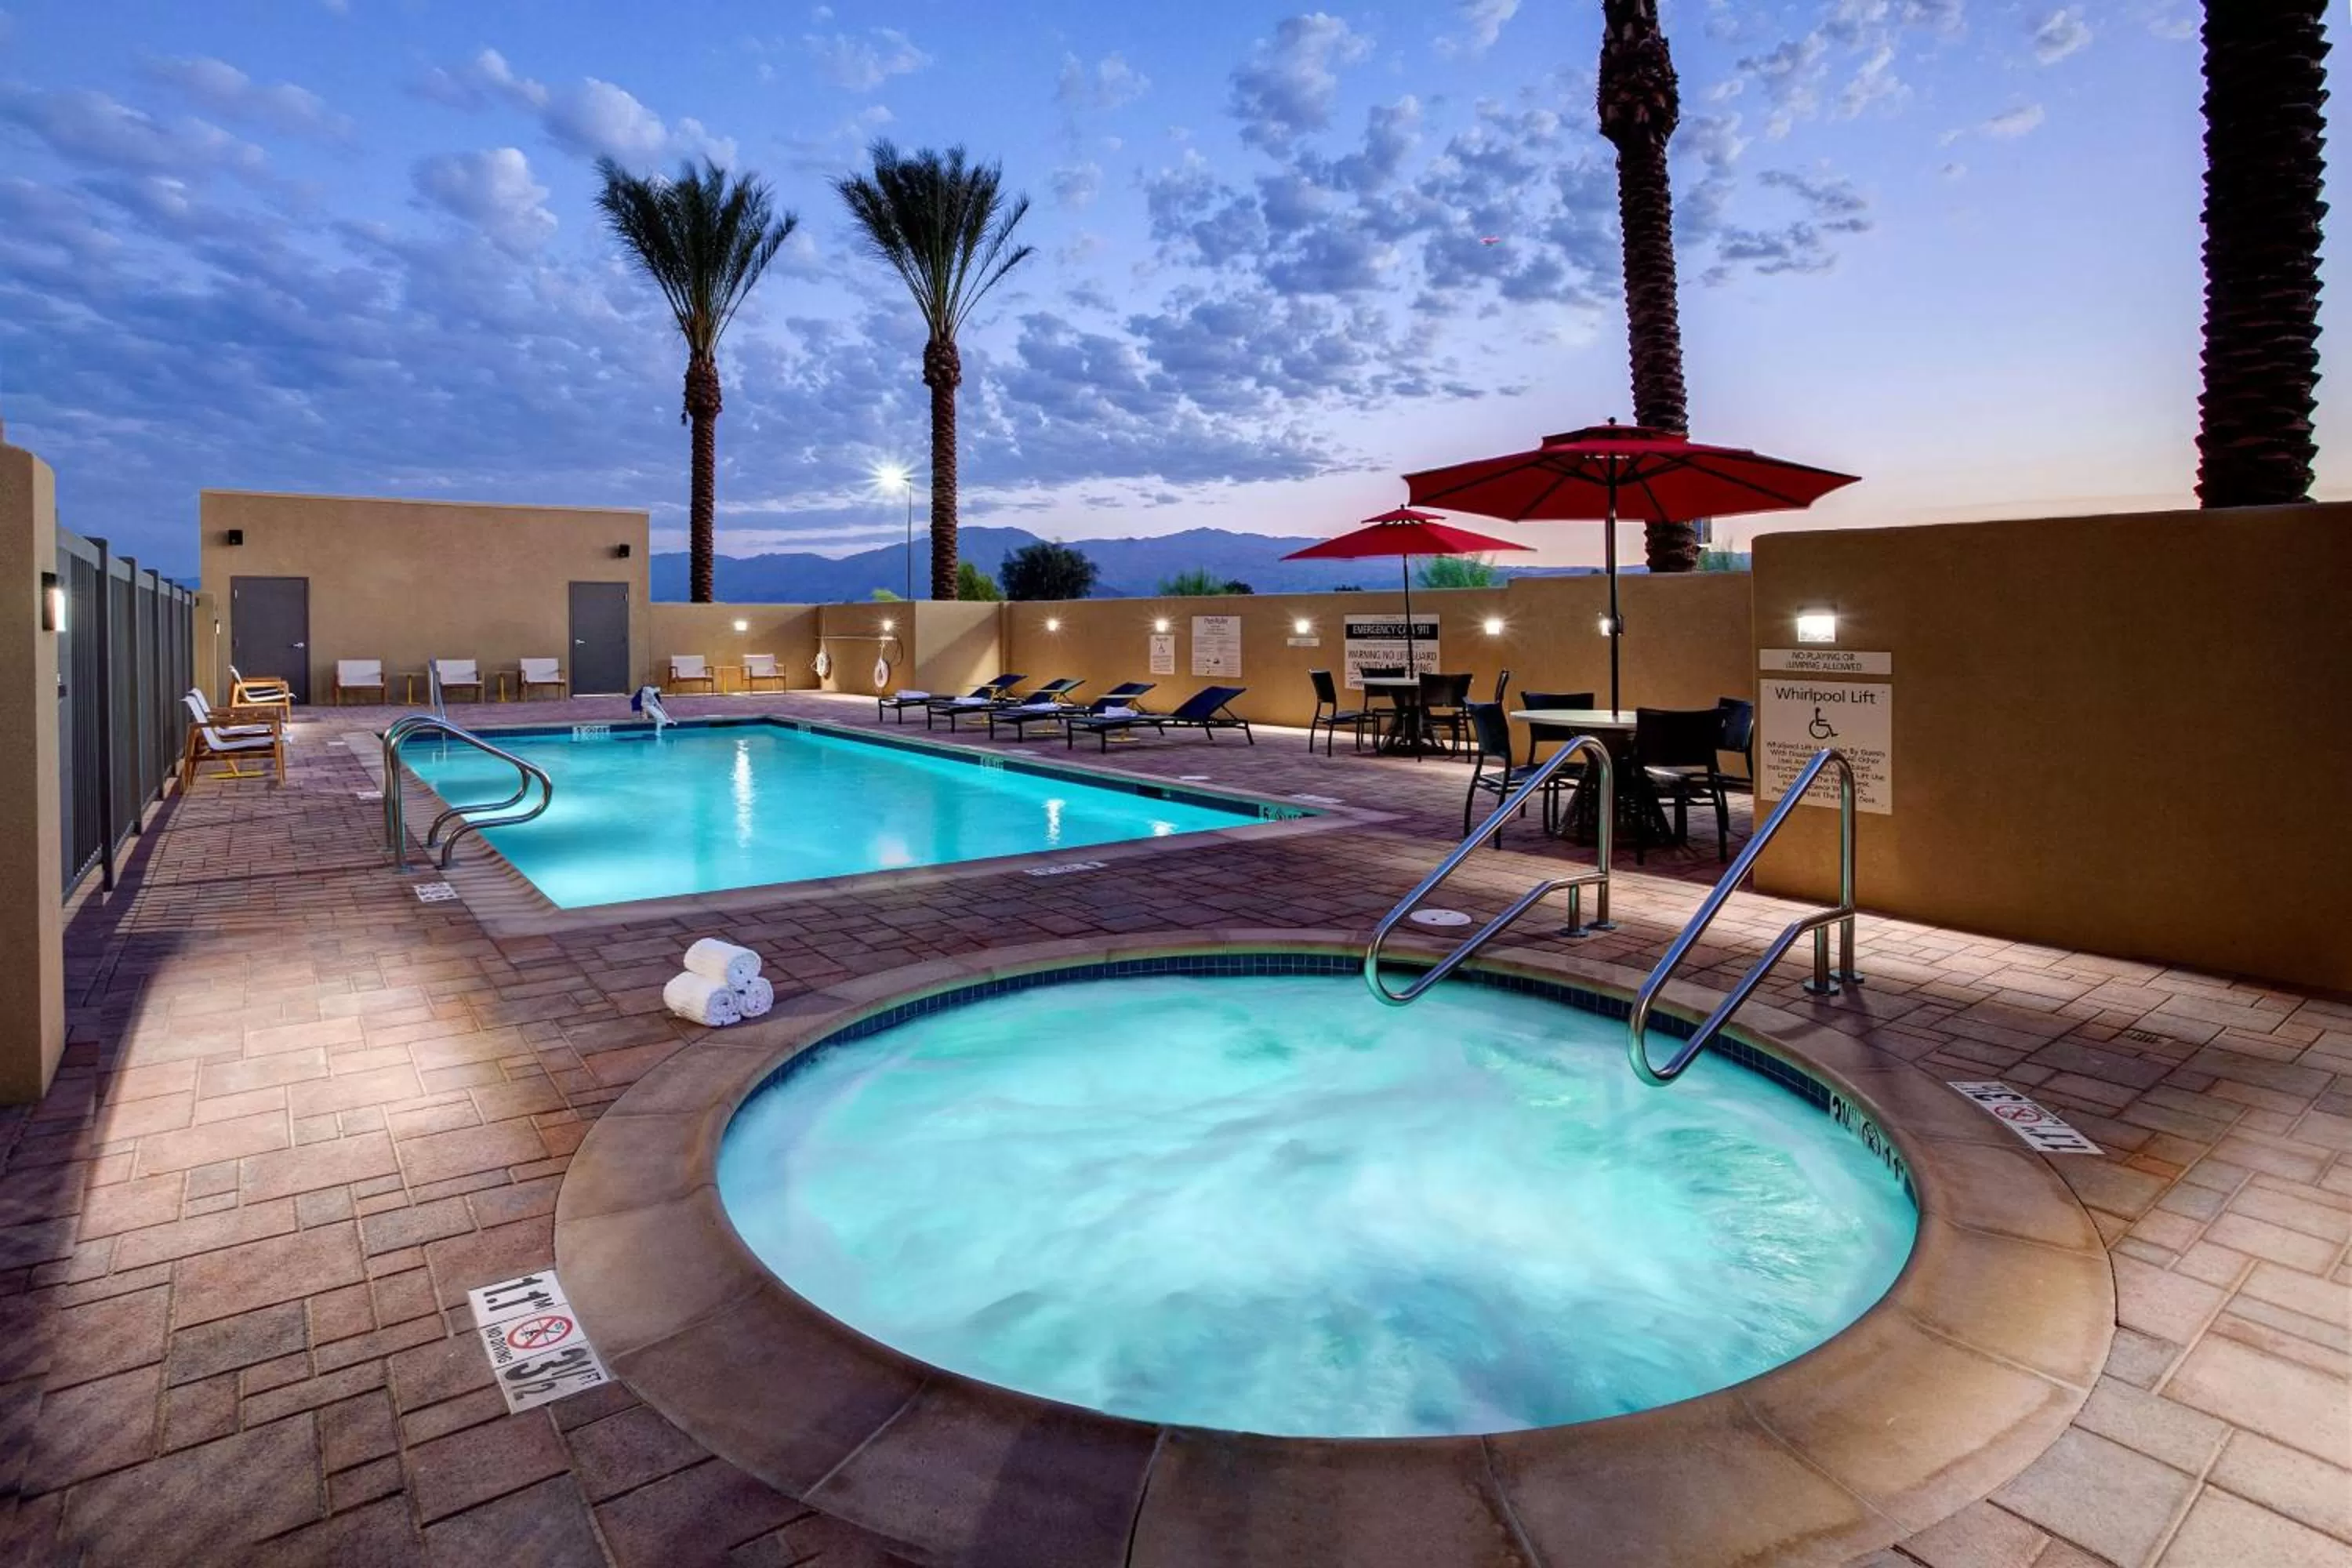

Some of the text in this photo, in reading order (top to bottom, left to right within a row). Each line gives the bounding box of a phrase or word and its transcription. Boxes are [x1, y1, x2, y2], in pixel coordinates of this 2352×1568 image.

[1352, 625, 1430, 634] EMERGENCY CAL 911
[1348, 650, 1437, 661] WARNING NO LIFEUARD
[1806, 652, 1841, 661] PLAYING
[1785, 661, 1863, 671] JUMPING ALLOWED
[1774, 687, 1876, 704] Whirlpool Lift
[486, 1326, 514, 1364] NO DIVING
